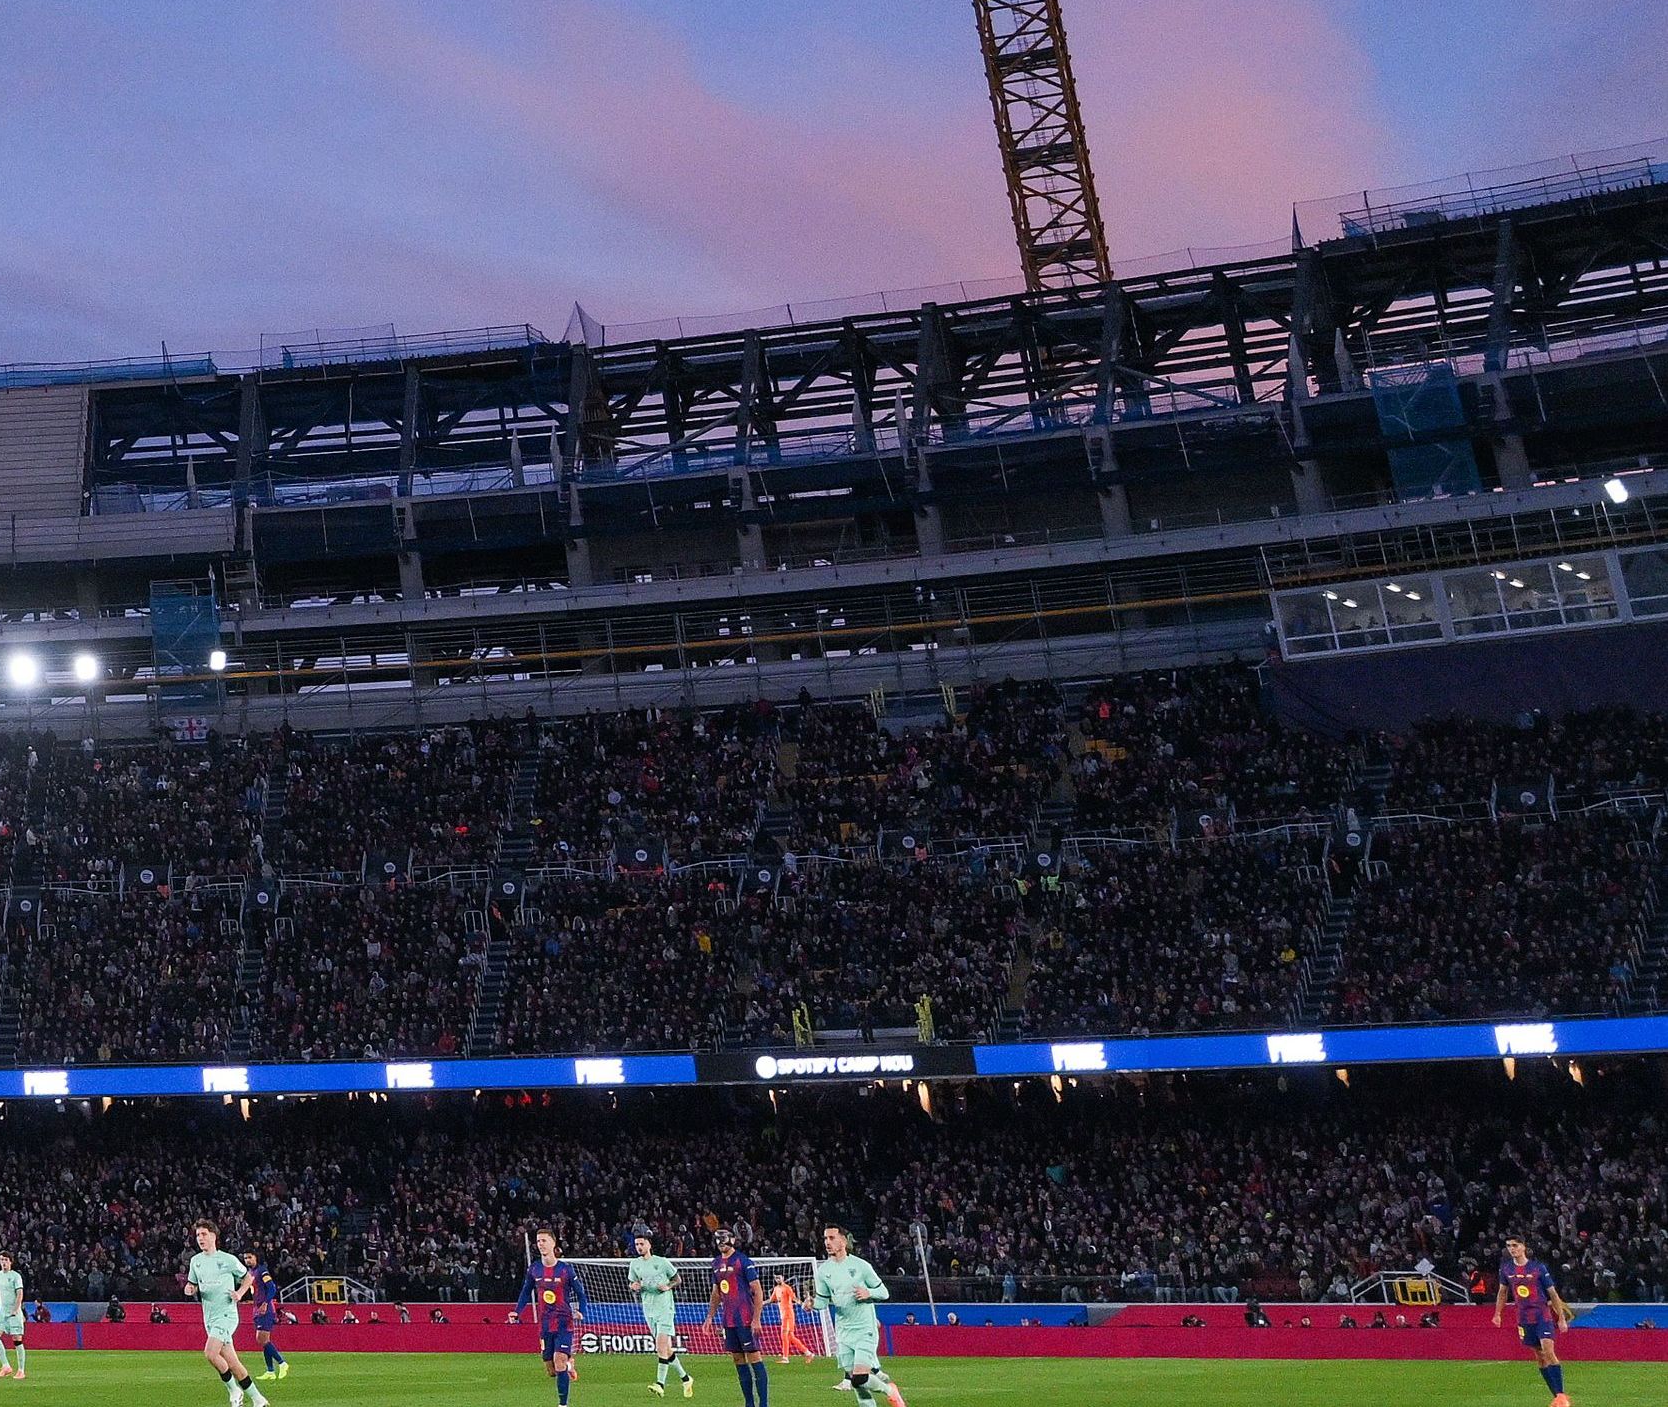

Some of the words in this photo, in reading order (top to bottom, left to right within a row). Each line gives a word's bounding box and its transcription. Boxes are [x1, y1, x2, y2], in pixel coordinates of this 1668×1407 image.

[777, 1056, 836, 1075] SPOTIFY
[836, 1055, 880, 1073] CAMP
[879, 1054, 914, 1072] NOU
